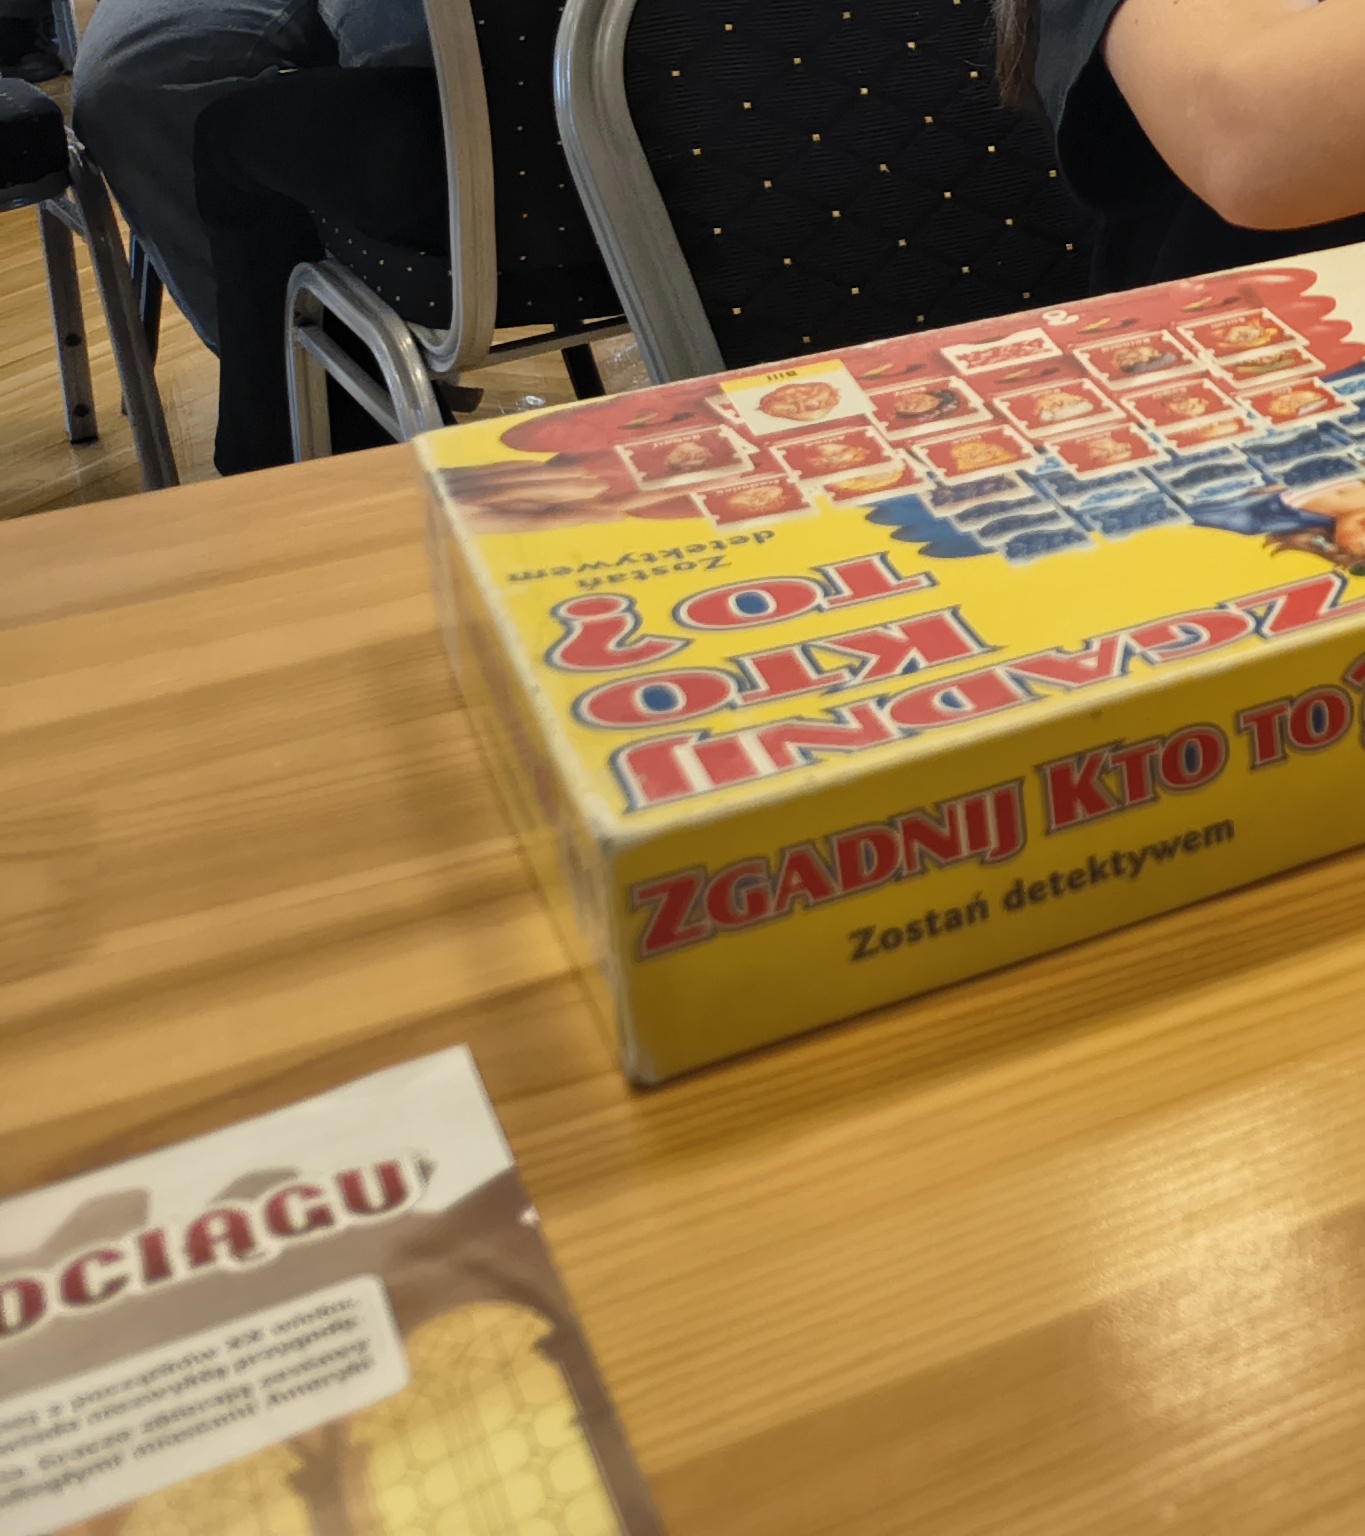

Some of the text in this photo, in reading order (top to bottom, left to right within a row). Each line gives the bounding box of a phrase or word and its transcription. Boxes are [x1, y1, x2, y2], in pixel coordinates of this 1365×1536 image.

[766, 369, 799, 383] Bill
[506, 529, 776, 585] detektywem
[545, 552, 939, 672] TO?
[576, 553, 731, 591] Zostań
[573, 607, 1003, 730] KTO
[631, 777, 1027, 960] ZGADNIJ
[1036, 724, 1228, 837] KTO
[849, 819, 1236, 962] Zostań detektywem
